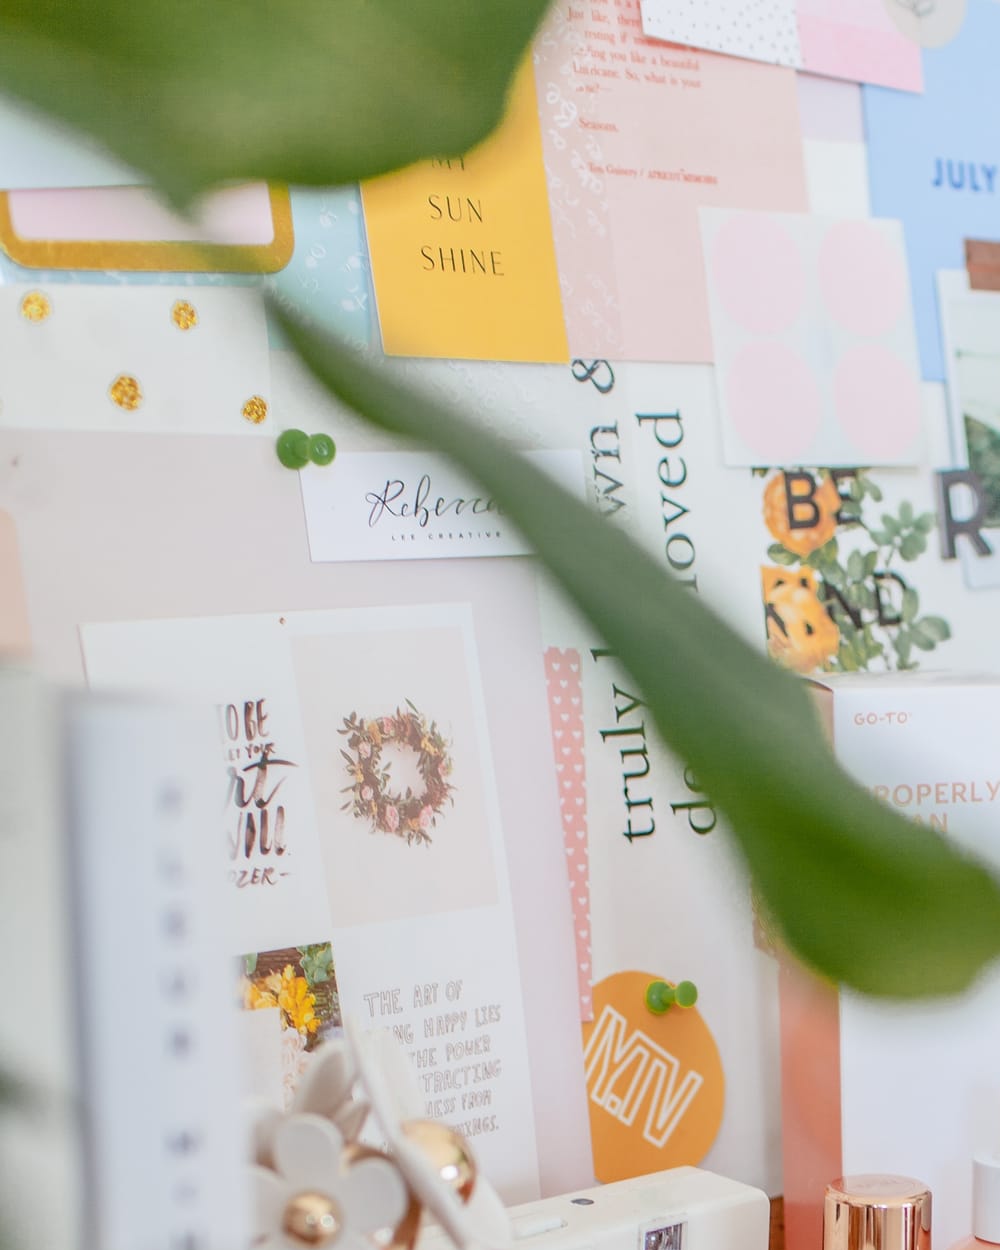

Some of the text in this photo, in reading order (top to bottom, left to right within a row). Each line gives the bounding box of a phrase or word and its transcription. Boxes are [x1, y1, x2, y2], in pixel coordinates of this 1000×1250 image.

[931, 156, 998, 194] JULY
[428, 194, 483, 223] SUN
[420, 245, 505, 276] SHINE
[570, 358, 616, 394] &
[853, 711, 909, 726] GO-TO
[363, 979, 464, 1018] THE ART OF
[423, 1010, 469, 1039] HAPPY
[475, 1003, 502, 1028] LIES
[445, 1033, 492, 1063] POWER
[421, 1058, 503, 1095] TRACTING
